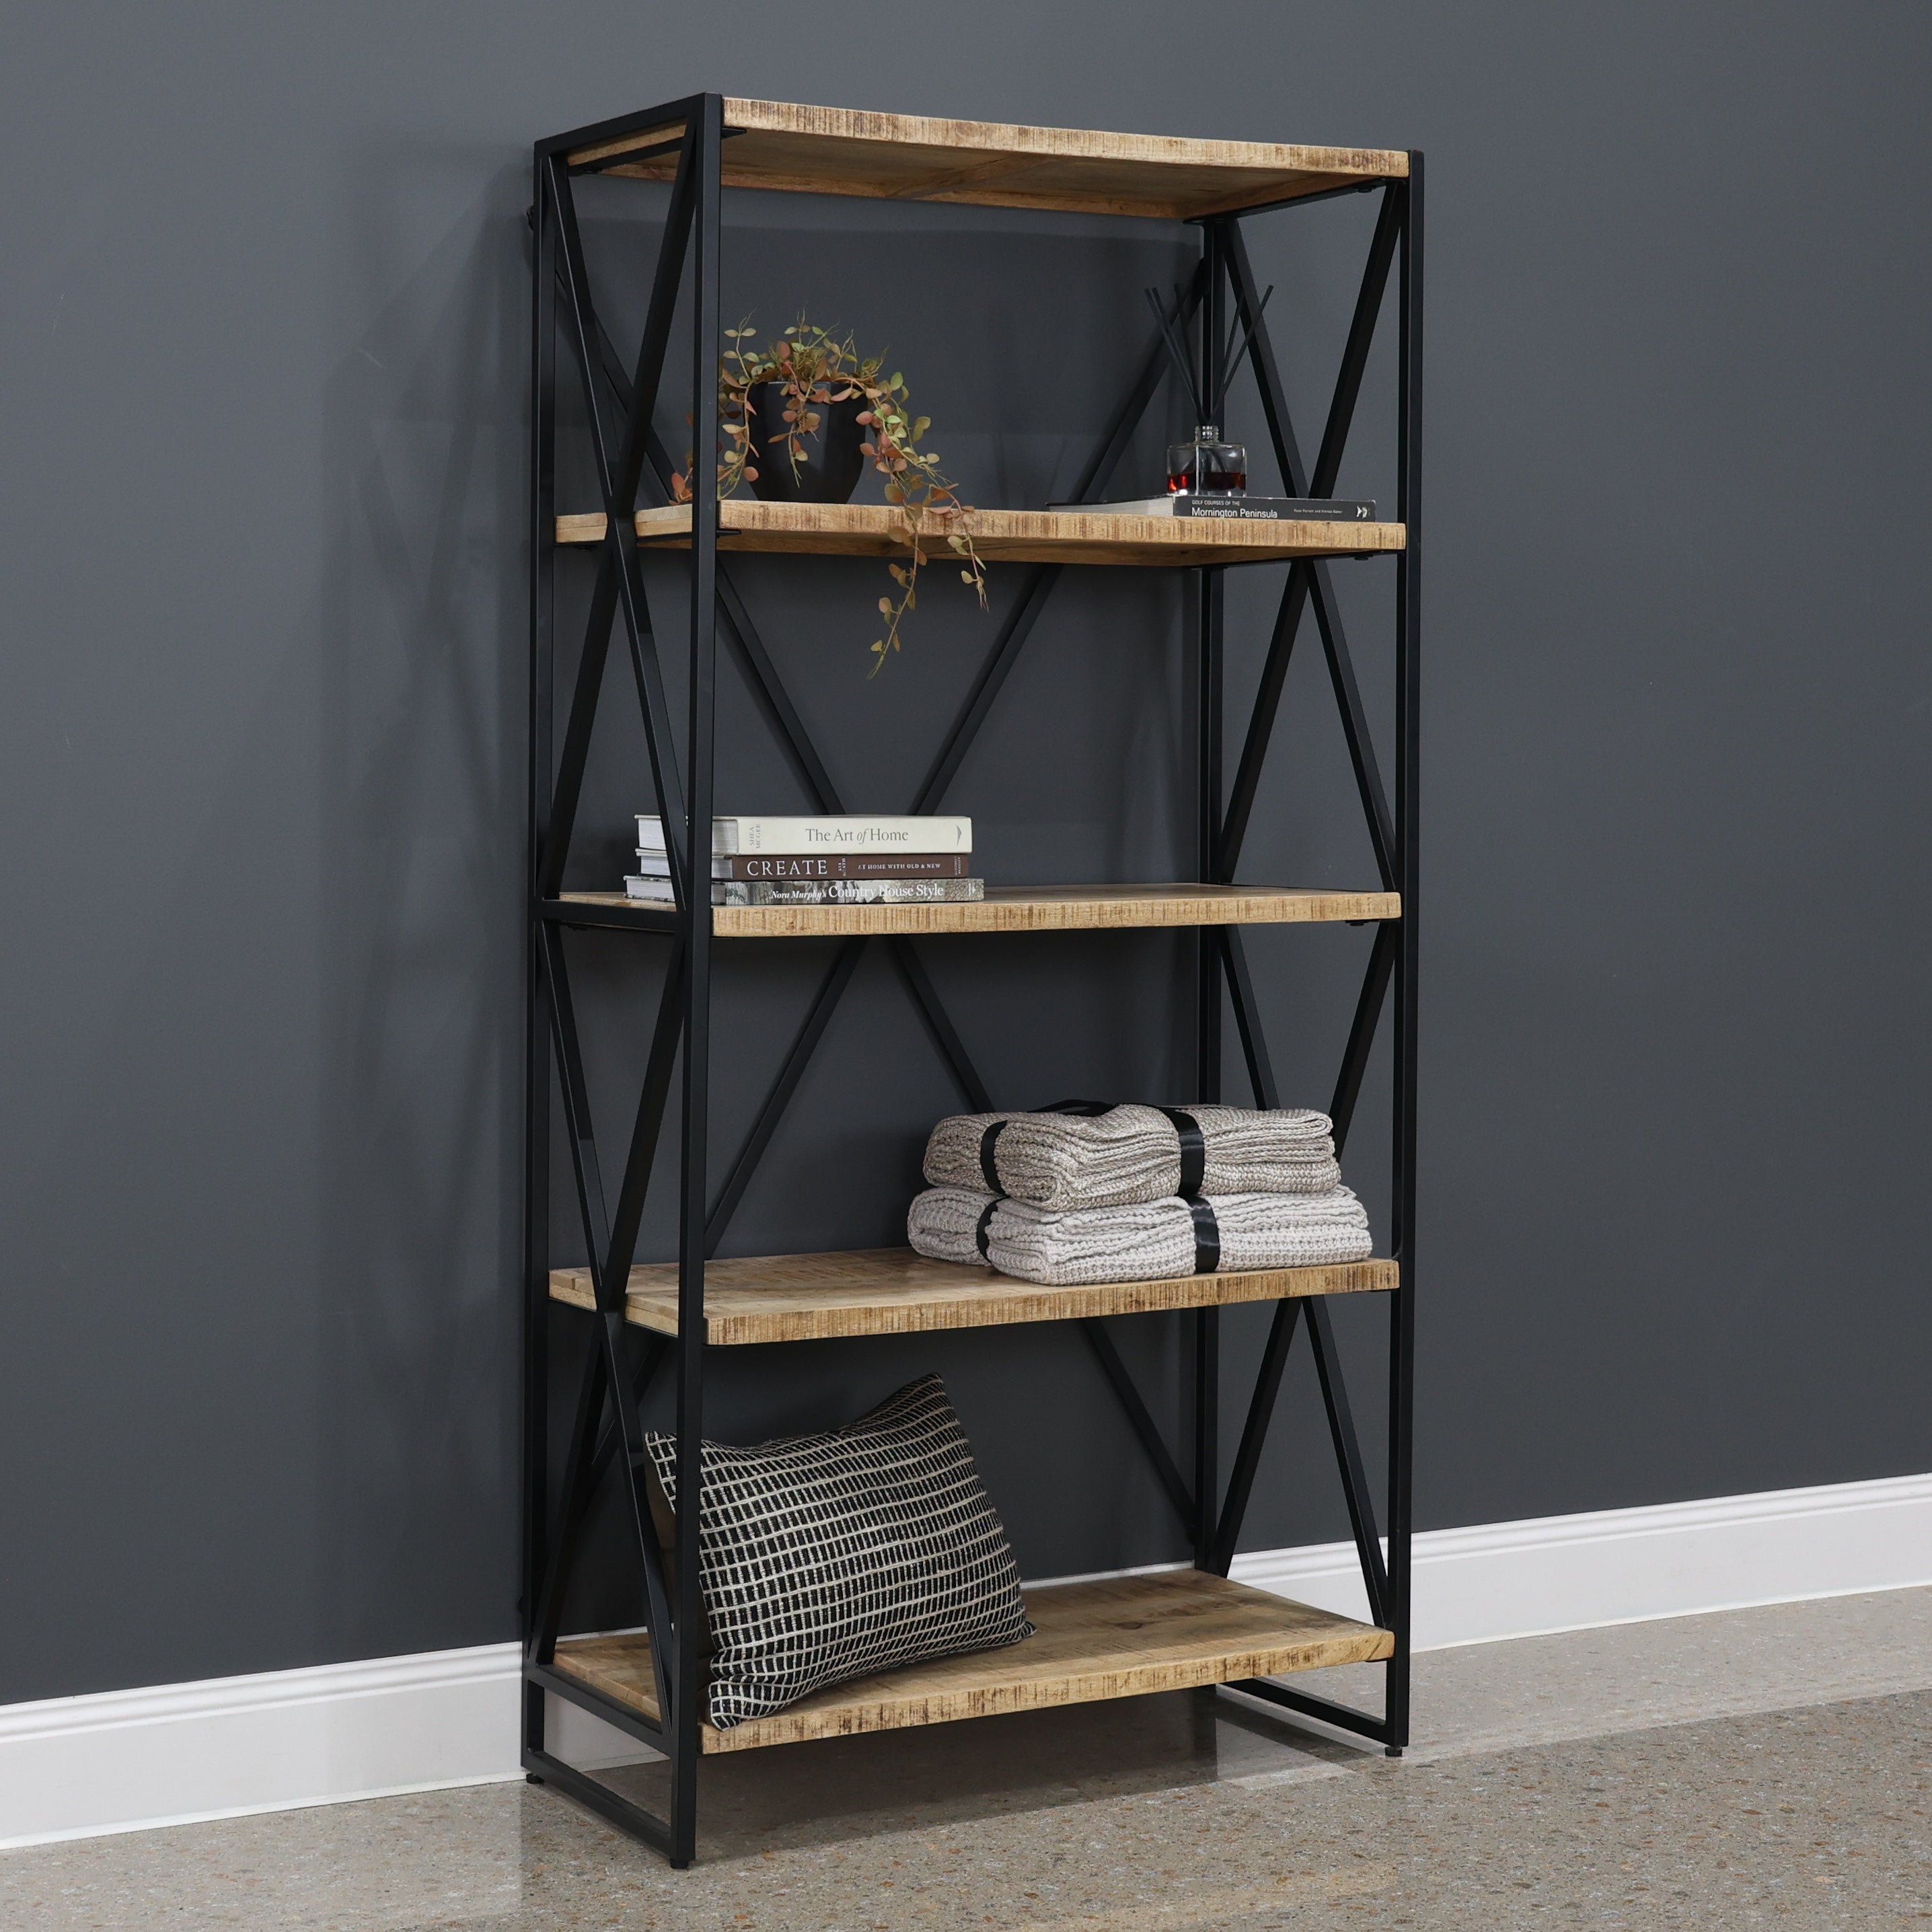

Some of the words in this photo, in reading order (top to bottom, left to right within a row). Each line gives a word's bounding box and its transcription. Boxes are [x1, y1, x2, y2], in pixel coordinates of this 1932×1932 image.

[1191, 507, 1237, 519] Mornington
[1240, 508, 1278, 519] Peninsula
[805, 828, 831, 842] The
[833, 828, 854, 842] Art
[856, 828, 869, 845] of
[870, 828, 909, 842] Home
[747, 859, 828, 877] CREATE
[771, 890, 790, 899] Nora
[791, 889, 827, 901] Murphy's
[828, 885, 877, 899] Country
[879, 884, 914, 897] House
[916, 883, 944, 899] Style
